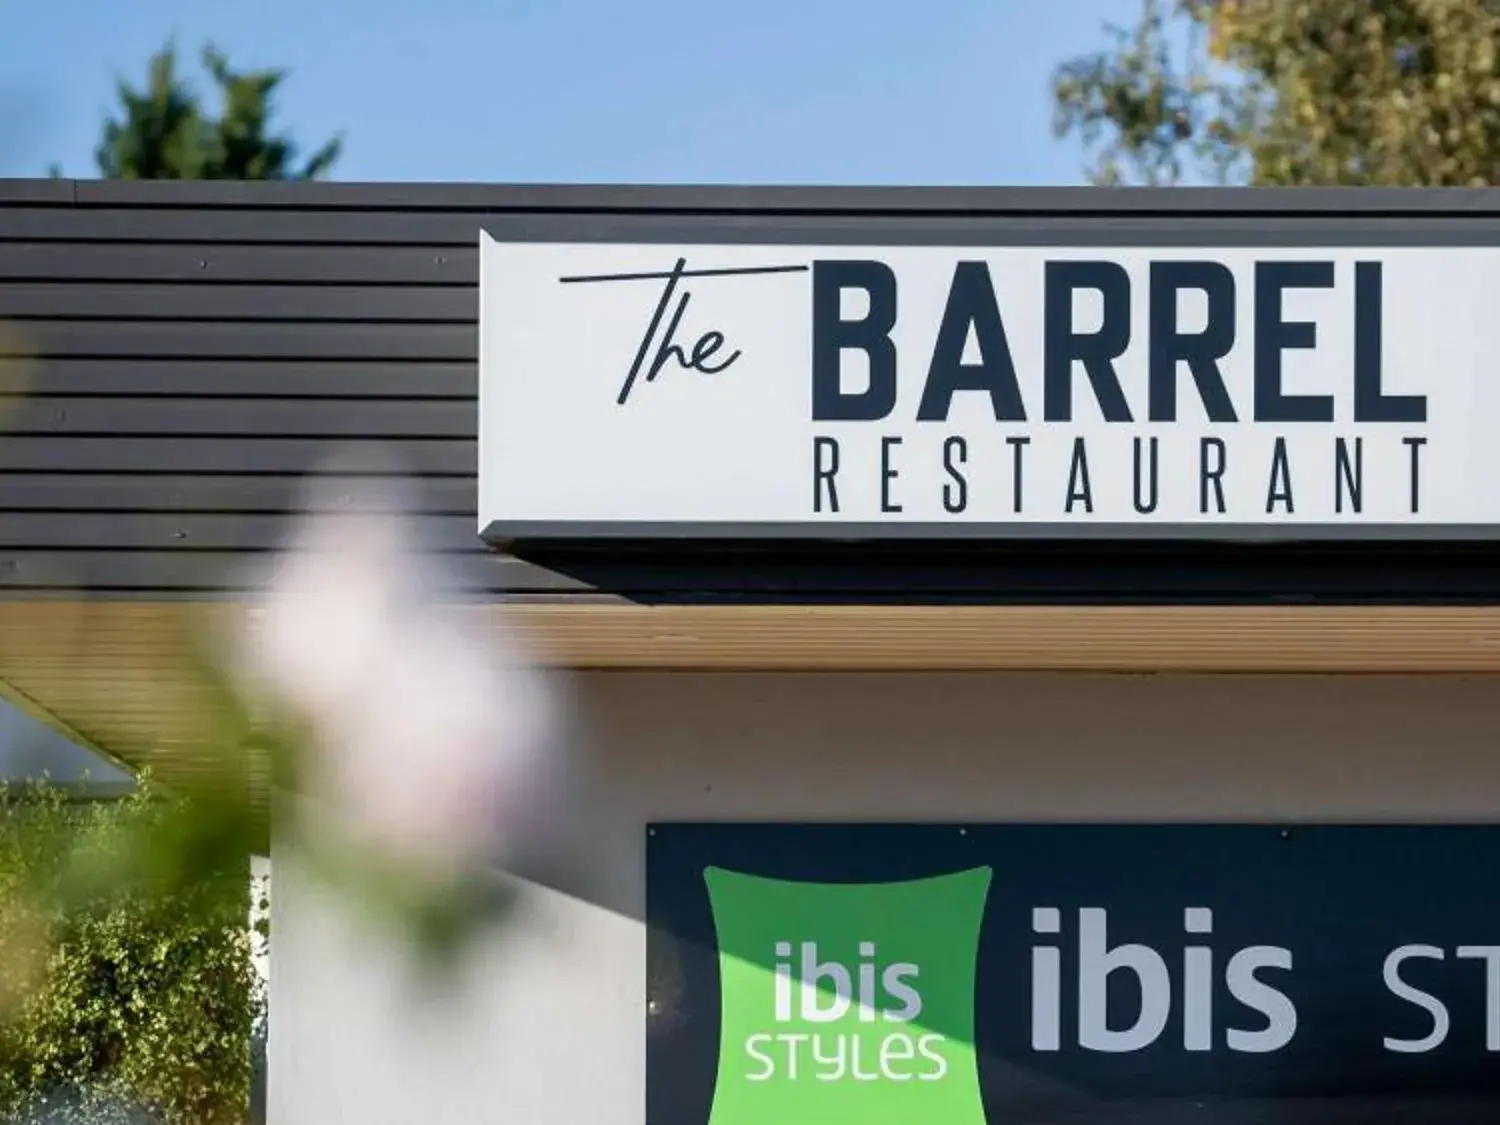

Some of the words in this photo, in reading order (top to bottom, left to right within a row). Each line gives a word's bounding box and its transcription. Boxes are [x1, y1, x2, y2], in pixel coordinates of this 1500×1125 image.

[559, 257, 809, 405] The
[811, 259, 1428, 423] BARREL
[813, 436, 1428, 515] RESTAURANT
[773, 941, 924, 1024] ibis
[1031, 907, 1297, 1053] ibis
